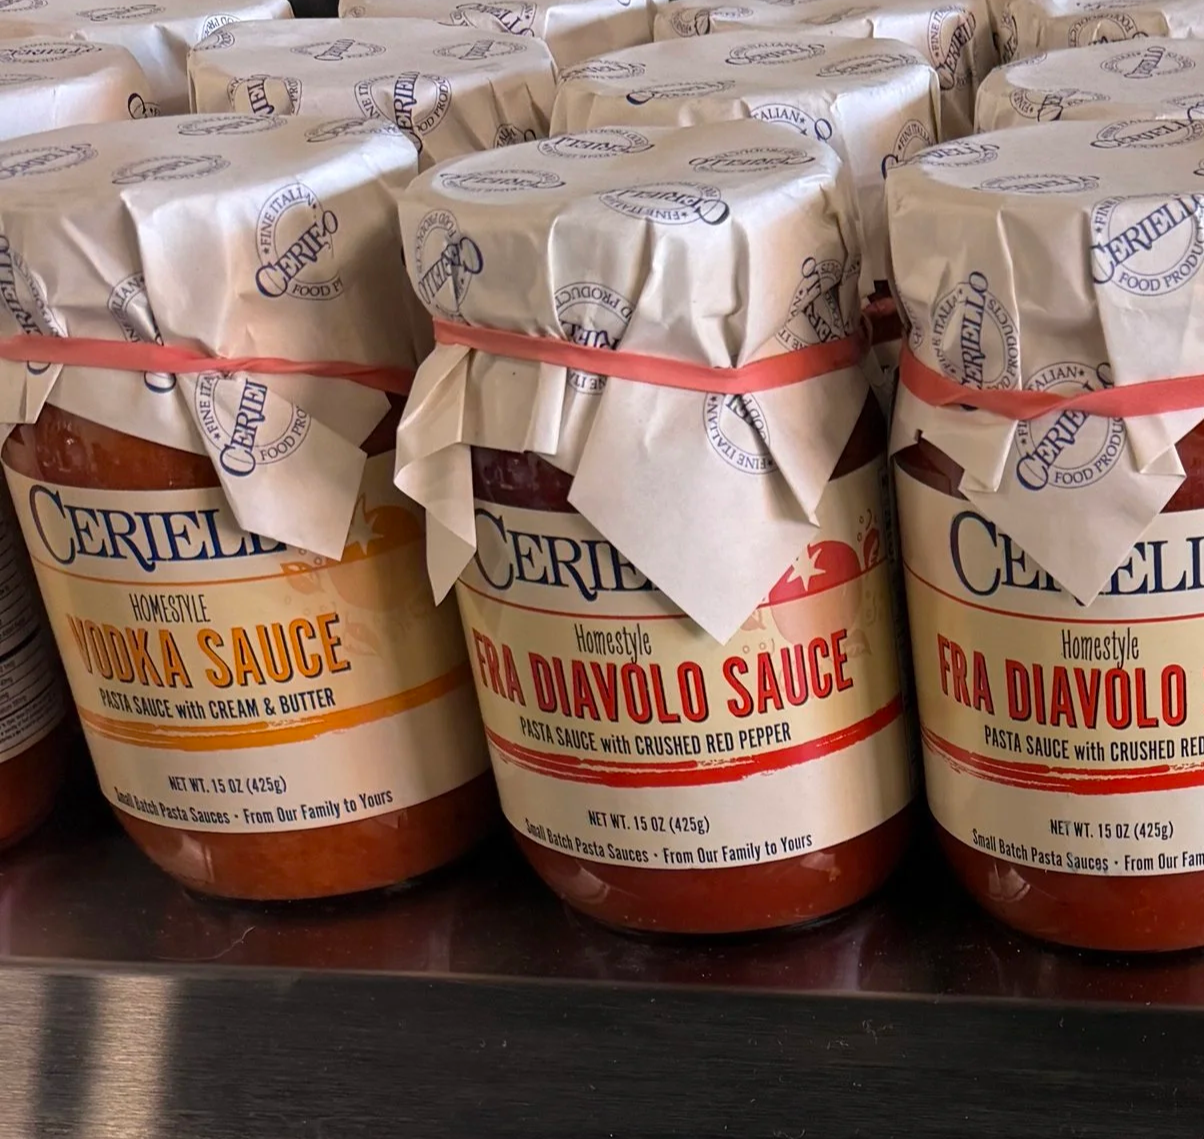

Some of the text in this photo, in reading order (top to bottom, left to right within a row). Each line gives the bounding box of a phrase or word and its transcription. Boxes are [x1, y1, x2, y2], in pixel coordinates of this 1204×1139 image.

[260, 212, 276, 246] FINE
[292, 283, 331, 297] FOOD
[1119, 271, 1161, 292] FOOD
[200, 400, 218, 434] FINE
[220, 378, 268, 477] CERIE
[260, 436, 295, 461] FOOD
[736, 452, 768, 471] FINE
[1055, 417, 1123, 484] FOOD PRODUC
[29, 484, 287, 573] CERIEL
[475, 508, 659, 602] CERIE
[129, 593, 211, 623] HOMESTYLE
[66, 612, 352, 688] VODKA SAUCE
[574, 623, 652, 662] Homestyle
[1060, 629, 1140, 669] Homestyle
[472, 627, 854, 724] FRA DIAVOLO SAUCE
[937, 633, 995, 716] FRA
[1005, 663, 1187, 731] DIAVOLO
[99, 687, 336, 720] PASTA SAUCE with CREAM & BUTTER
[519, 716, 792, 757] PASTA SAUCE with CRUSHED RED PEPPER
[984, 726, 1022, 753] PASTA
[1026, 735, 1070, 761] SAUCE
[1074, 741, 1106, 762] with
[1110, 738, 1176, 762] CRUSHED
[168, 775, 287, 795] NET WT. 15 OZ (425g)
[134, 796, 159, 816] Batch
[160, 803, 188, 820] Pasta
[190, 807, 230, 824] Sauces
[243, 808, 274, 825] From
[277, 806, 298, 822] Our
[301, 800, 341, 822] Family
[344, 798, 356, 813] to
[359, 790, 393, 810] Yours
[588, 810, 710, 835] NET WT. 15 OZ (425g)
[525, 817, 813, 864] Small Batch Pasta Sauces From Our Family to Yours
[1050, 818, 1174, 841] NET WT. 15 OZ (425g)
[972, 828, 997, 853] Small
[999, 839, 1029, 863] Batch
[1031, 848, 1063, 868] Pasta
[1066, 852, 1110, 872] Sauces
[1124, 854, 1155, 872] From
[1158, 853, 1179, 870] Our
